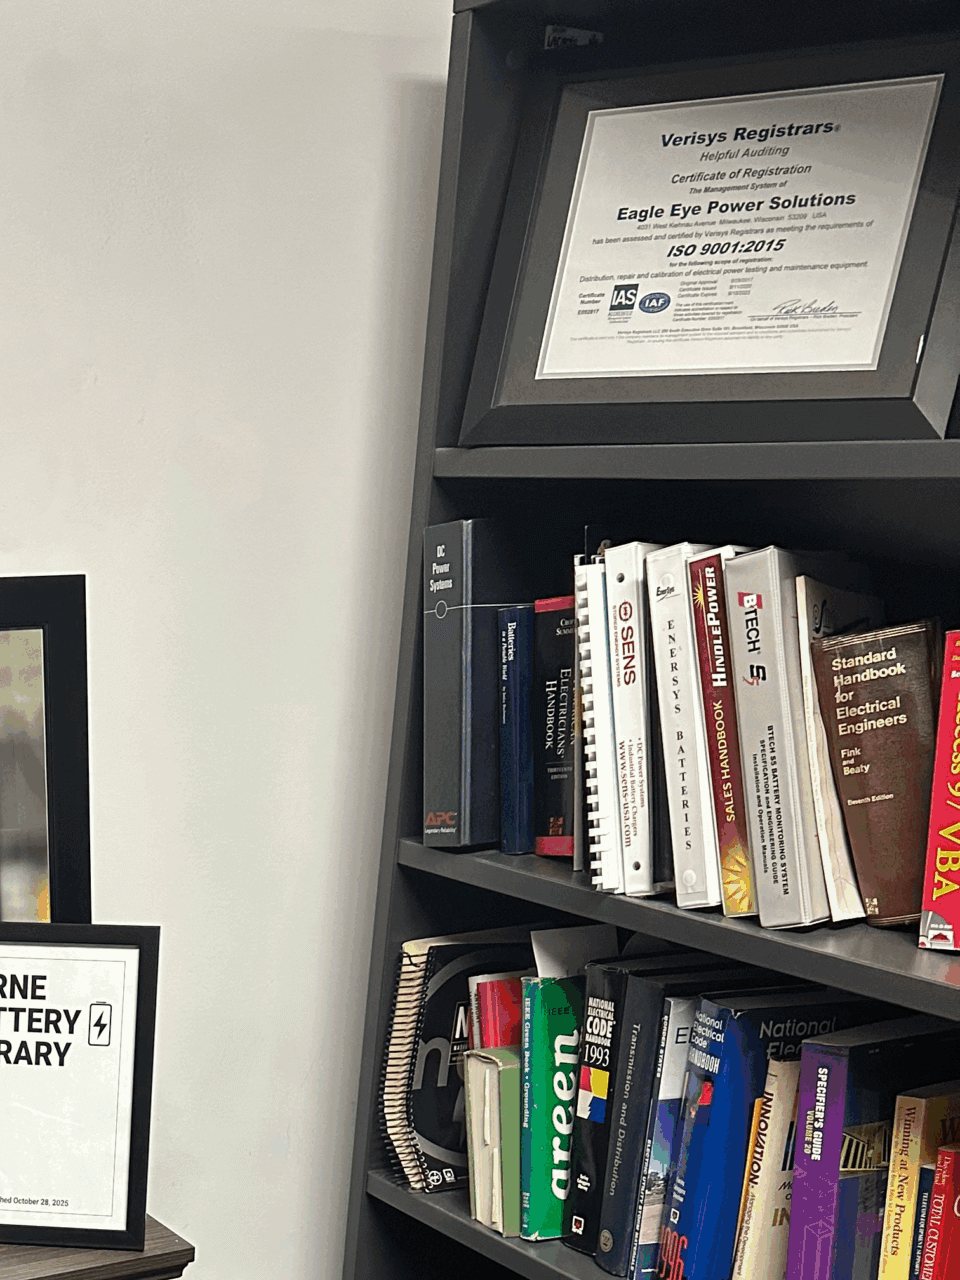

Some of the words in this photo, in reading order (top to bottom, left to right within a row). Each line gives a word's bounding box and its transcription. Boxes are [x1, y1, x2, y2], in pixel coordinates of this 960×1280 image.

[661, 129, 727, 147] Verisys
[699, 149, 740, 162] Helpful
[742, 145, 790, 159] Auditing
[671, 170, 727, 184] Certificate
[729, 169, 741, 180] of
[742, 164, 812, 179] Registration
[689, 187, 701, 195] The
[703, 184, 749, 194] Management
[750, 181, 778, 192] System
[617, 205, 664, 222] Eagle
[669, 203, 701, 219] Eye
[707, 200, 764, 214] Power
[768, 193, 856, 210] Solutions
[622, 234, 653, 243] assessed
[668, 230, 694, 240] certified
[704, 228, 729, 239] Verisys
[730, 226, 764, 237] Registrars
[776, 223, 803, 233] meeting
[818, 221, 864, 231] requirements
[667, 245, 697, 257] ISO
[699, 238, 787, 255] 9001:2015
[579, 274, 615, 283] Distribution,
[650, 270, 683, 279] calibration
[693, 267, 722, 276] electrical
[723, 267, 743, 275] power
[745, 265, 768, 274] testing
[784, 262, 828, 271] maintenance
[612, 289, 637, 306] IAS
[645, 298, 665, 307] IAF
[436, 544, 446, 558] DC
[432, 562, 450, 575] Power
[429, 579, 453, 594] Systems
[655, 586, 676, 597] EnerSys
[507, 621, 517, 661] Batteries
[621, 625, 637, 686] SENS
[831, 647, 897, 672] Standard
[833, 662, 906, 688] Handbook
[835, 690, 855, 704] for
[836, 696, 902, 720] Electrical
[544, 679, 558, 750] HANDBOOK
[556, 667, 572, 759] ELECTRICIANS'
[838, 713, 908, 736] Engineers
[637, 742, 643, 754] DC
[713, 699, 731, 780] HANDBOOK
[766, 724, 776, 754] BTECH
[627, 744, 636, 779] Industrial
[841, 747, 861, 759] Fink
[842, 758, 855, 766] and
[843, 764, 870, 776] Beaty
[619, 740, 632, 848] www.sens-usa.com
[771, 766, 781, 805] BATTERY
[871, 793, 894, 802] Edition
[721, 778, 736, 823] SALES
[752, 753, 761, 793] Installation
[758, 808, 766, 843] Operation
[425, 811, 457, 826] APC
[759, 739, 770, 794] SPECIFICATION
[766, 810, 776, 860] ENGINEERING
[771, 860, 779, 884] GUIDE
[774, 806, 786, 861] MONITORING
[932, 821, 960, 901] VBA
[778, 861, 790, 896] SYSTEM
[548, 1006, 570, 1016] IEEE
[587, 1006, 614, 1021] ELECTRICAL
[588, 996, 615, 1012] NATIONAL
[660, 1015, 669, 1047] BORDER
[693, 1022, 725, 1043] Electrical
[695, 1010, 724, 1031] National
[759, 1016, 837, 1039] National
[585, 1033, 611, 1048] HANDBOOK
[584, 1044, 610, 1067] 1993
[623, 1023, 642, 1099] Transmission
[656, 1048, 665, 1078] STATES
[522, 1082, 530, 1128] Grounding
[814, 1067, 828, 1129] SPECIFIER'S
[620, 1102, 628, 1126] and
[805, 1110, 815, 1142] VOLUME
[749, 1090, 774, 1186] INNOVATION
[899, 1106, 916, 1157] Winning
[803, 1143, 811, 1155] 20
[810, 1130, 823, 1162] GUIDE
[609, 1128, 627, 1197] Distribution
[899, 1158, 909, 1171] at
[897, 1174, 910, 1201] New
[13, 1196, 39, 1206] October
[41, 1197, 51, 1207] 28,
[52, 1198, 69, 1207] 2025
[930, 1193, 945, 1226] TOTAL
[891, 1203, 906, 1257] Products
